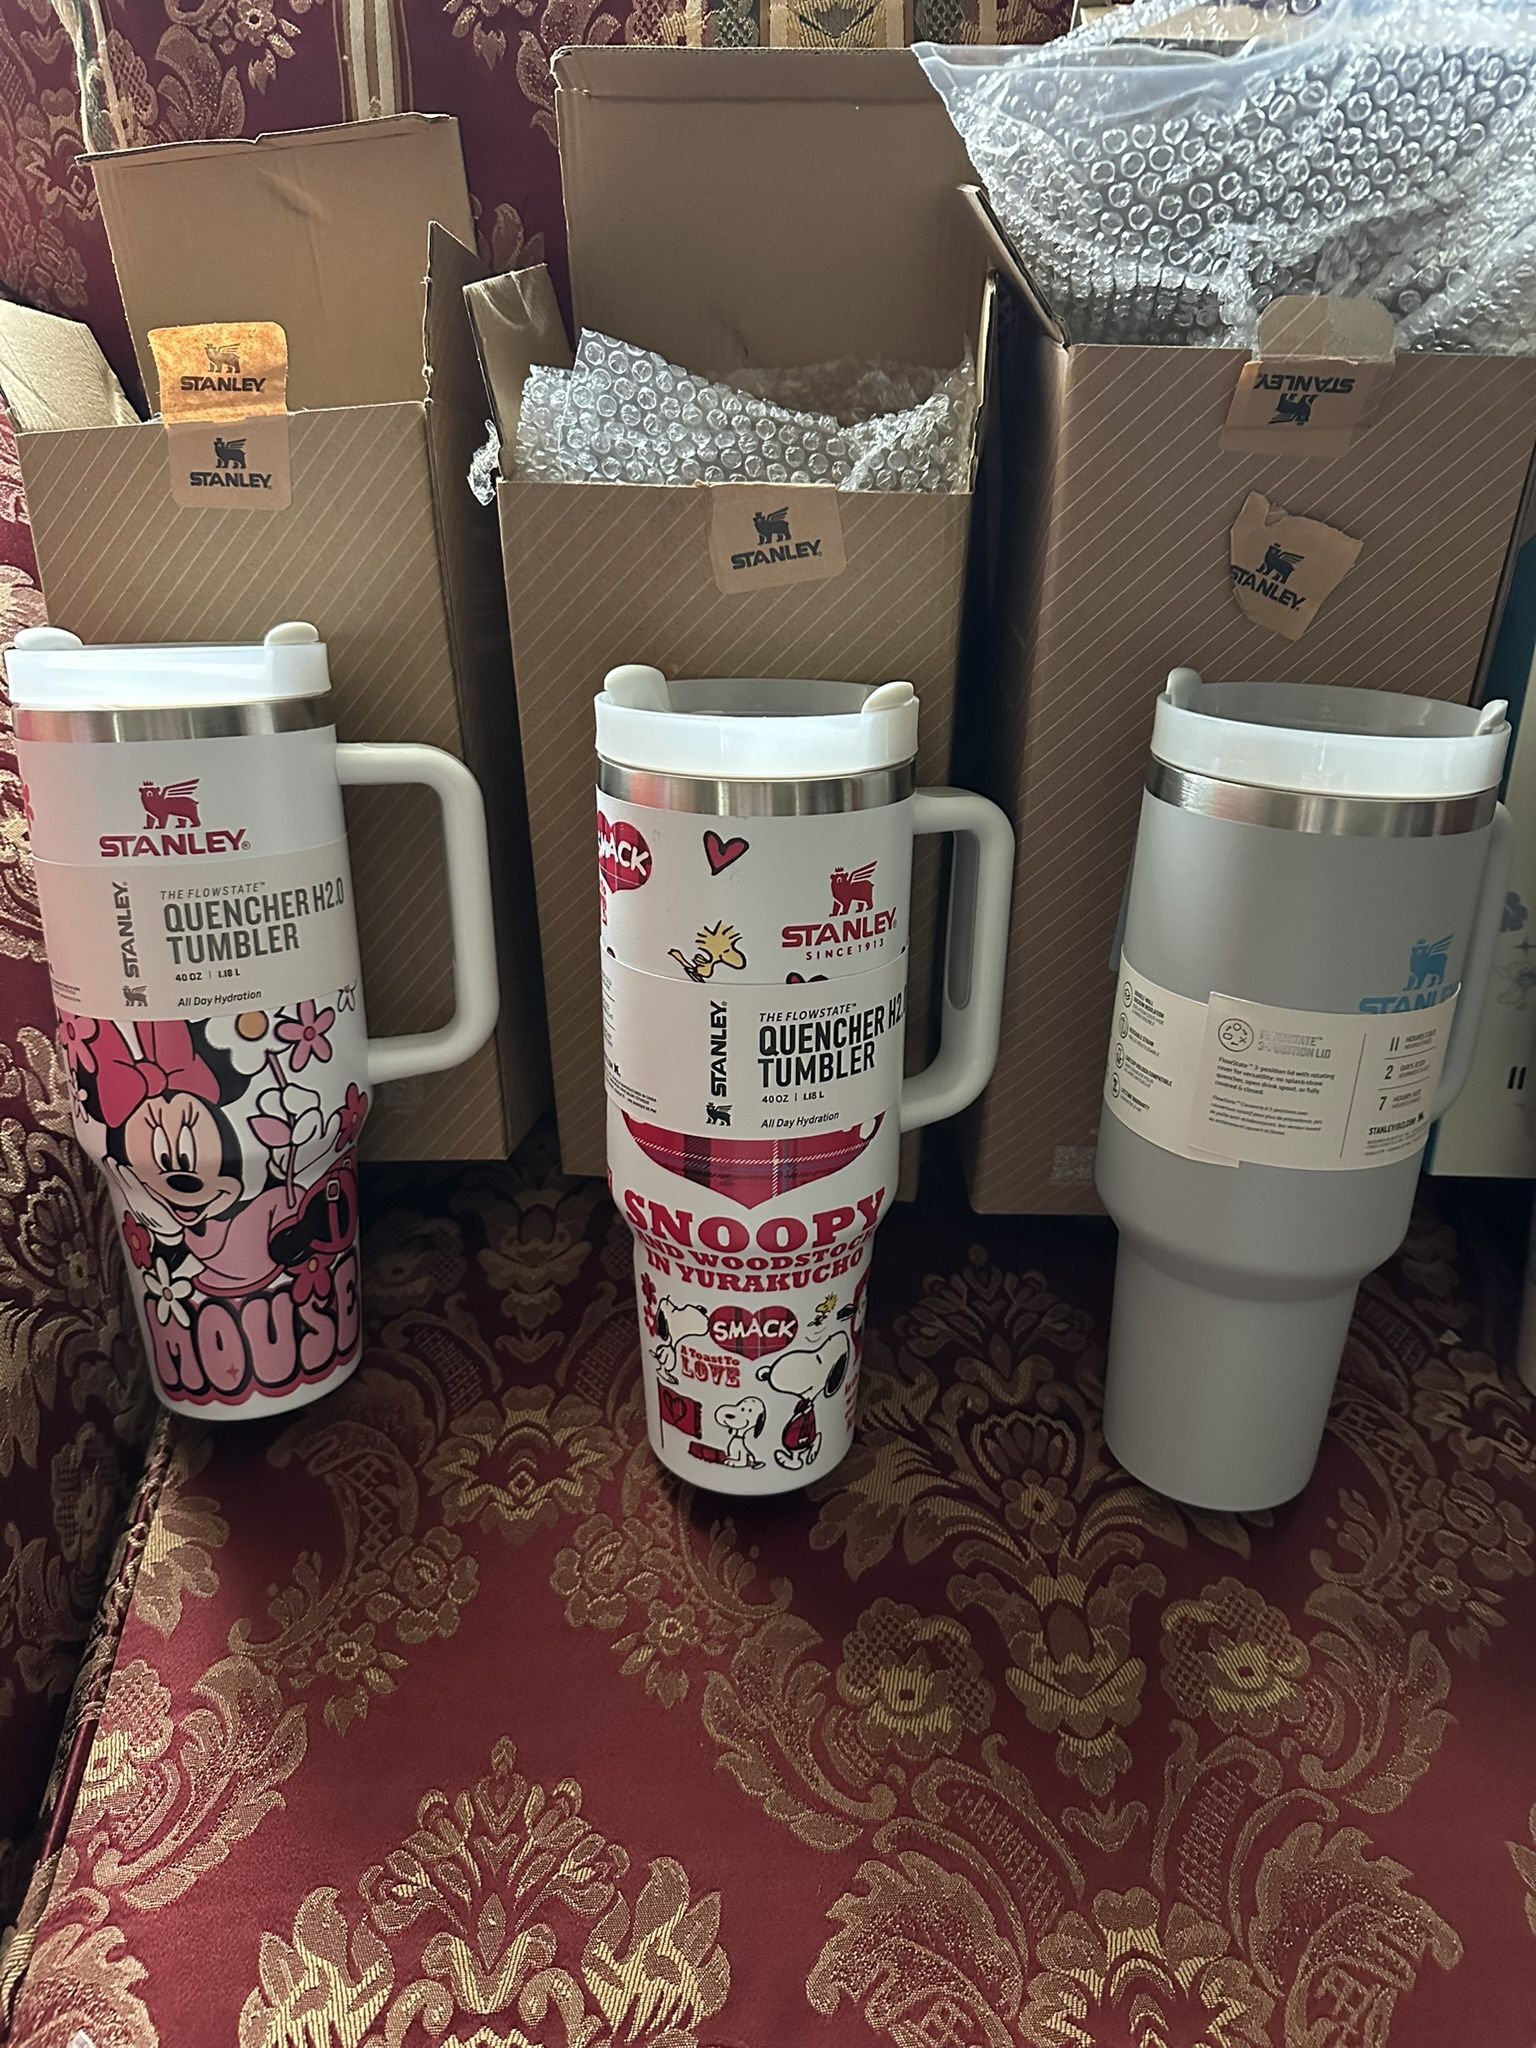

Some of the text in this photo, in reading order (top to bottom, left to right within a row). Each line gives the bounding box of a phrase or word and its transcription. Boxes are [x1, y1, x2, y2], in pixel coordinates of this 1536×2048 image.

[181, 375, 267, 392] STANLEY
[1253, 373, 1355, 393] STANLEY
[189, 471, 272, 490] STANLEY
[731, 539, 822, 570] STANLEY
[160, 889, 184, 900] THE
[163, 877, 345, 933] QUENCHER H2.0
[166, 922, 299, 965] TUMBLER
[805, 937, 884, 960] SINCE 1913
[175, 973, 187, 982] 40
[189, 972, 202, 981] OZ
[178, 990, 262, 1007] All Day Hydration
[759, 1012, 782, 1023] THE
[758, 1005, 885, 1057] QUENCHER
[757, 1039, 875, 1088] TUMBLER
[1316, 1048, 1332, 1059] LID
[1384, 1065, 1394, 1080] 2
[762, 1095, 774, 1104] 40
[775, 1094, 789, 1103] OZ
[1378, 1096, 1387, 1111] 7
[761, 1112, 840, 1129] All Day Hydration
[624, 1187, 885, 1254] SNOOPY
[645, 1246, 863, 1293] IN YURAKUCHO
[144, 1251, 361, 1397] MOUSE
[712, 1319, 798, 1342] SMACK
[681, 1344, 688, 1355] A
[724, 1356, 740, 1366] To
[681, 1354, 741, 1388] LOVE
